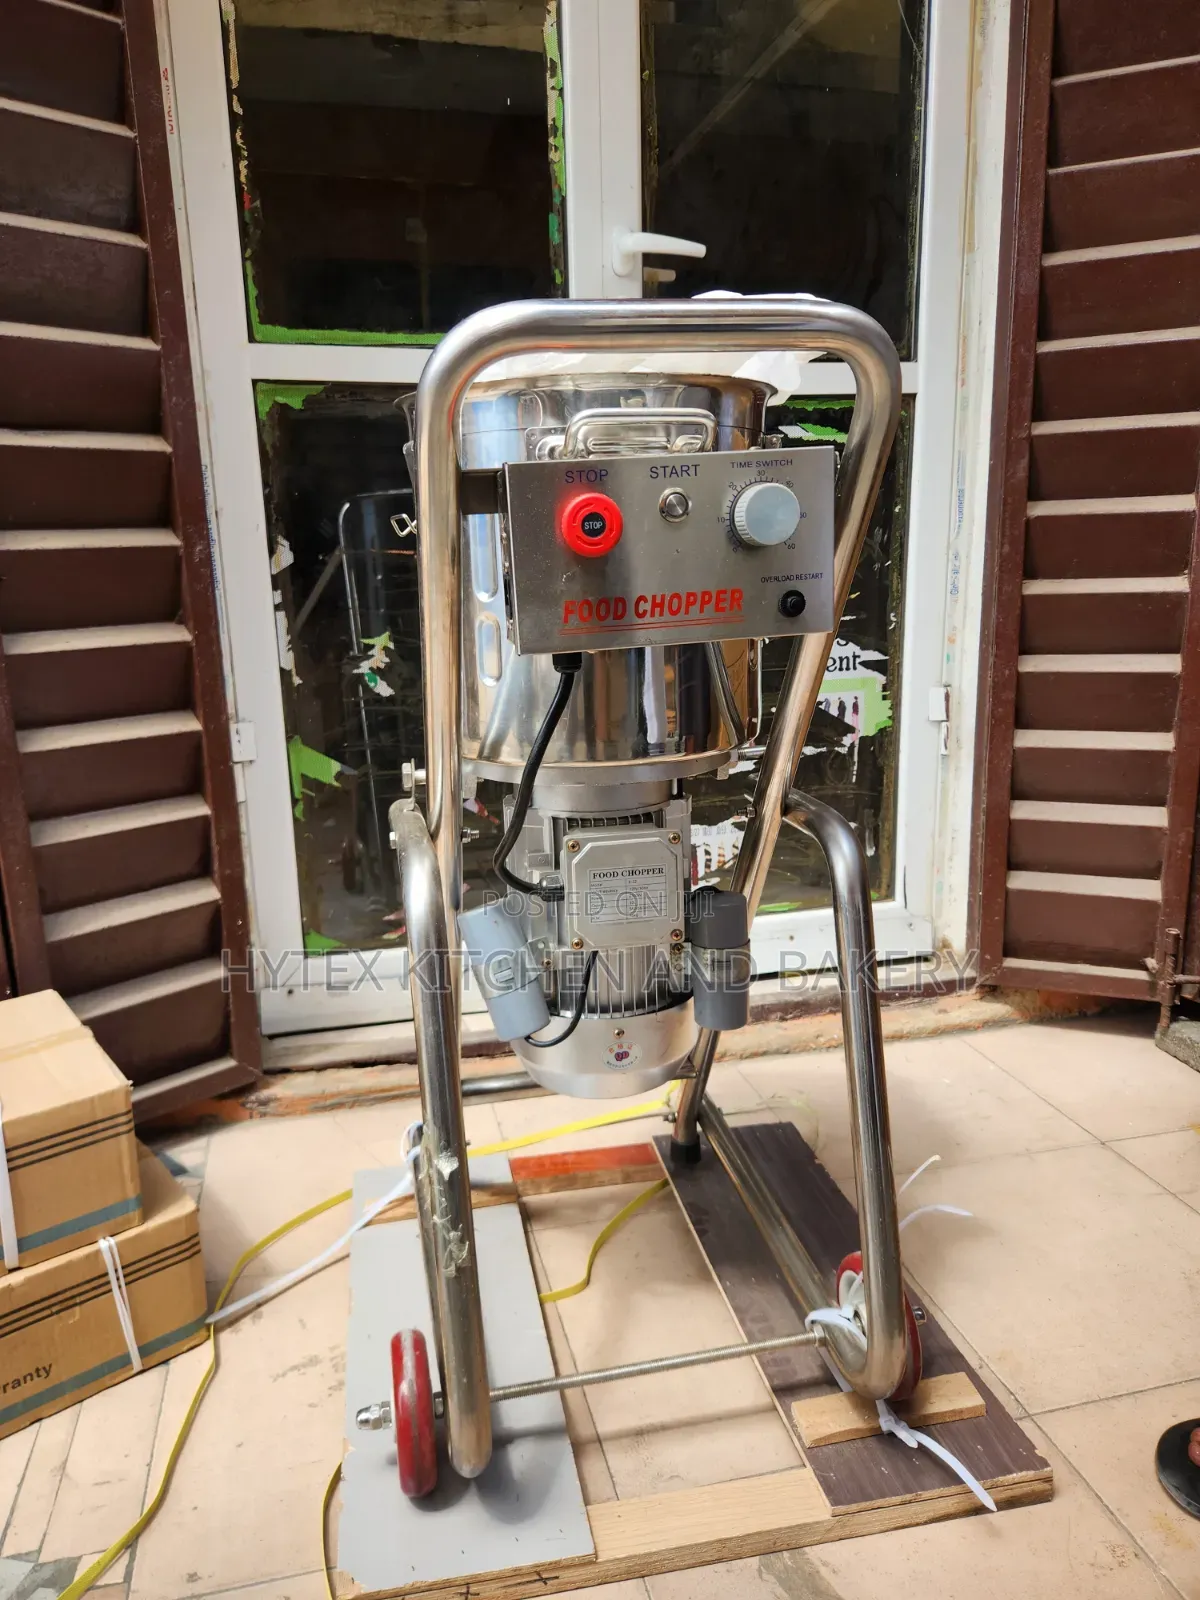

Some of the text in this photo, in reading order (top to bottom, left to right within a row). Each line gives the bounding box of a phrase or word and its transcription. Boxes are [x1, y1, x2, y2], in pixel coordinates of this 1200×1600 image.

[730, 459, 793, 469] TIME SWITCH
[564, 468, 609, 484] STOP
[649, 464, 700, 479] START
[728, 481, 737, 491] 20
[584, 520, 603, 531] STOP
[760, 572, 824, 584] OVERLOAD RESTART
[562, 588, 744, 624] FOOD CHOPPER
[592, 867, 664, 880] FOOD CHOPPER
[0, 1363, 52, 1394] ranty
